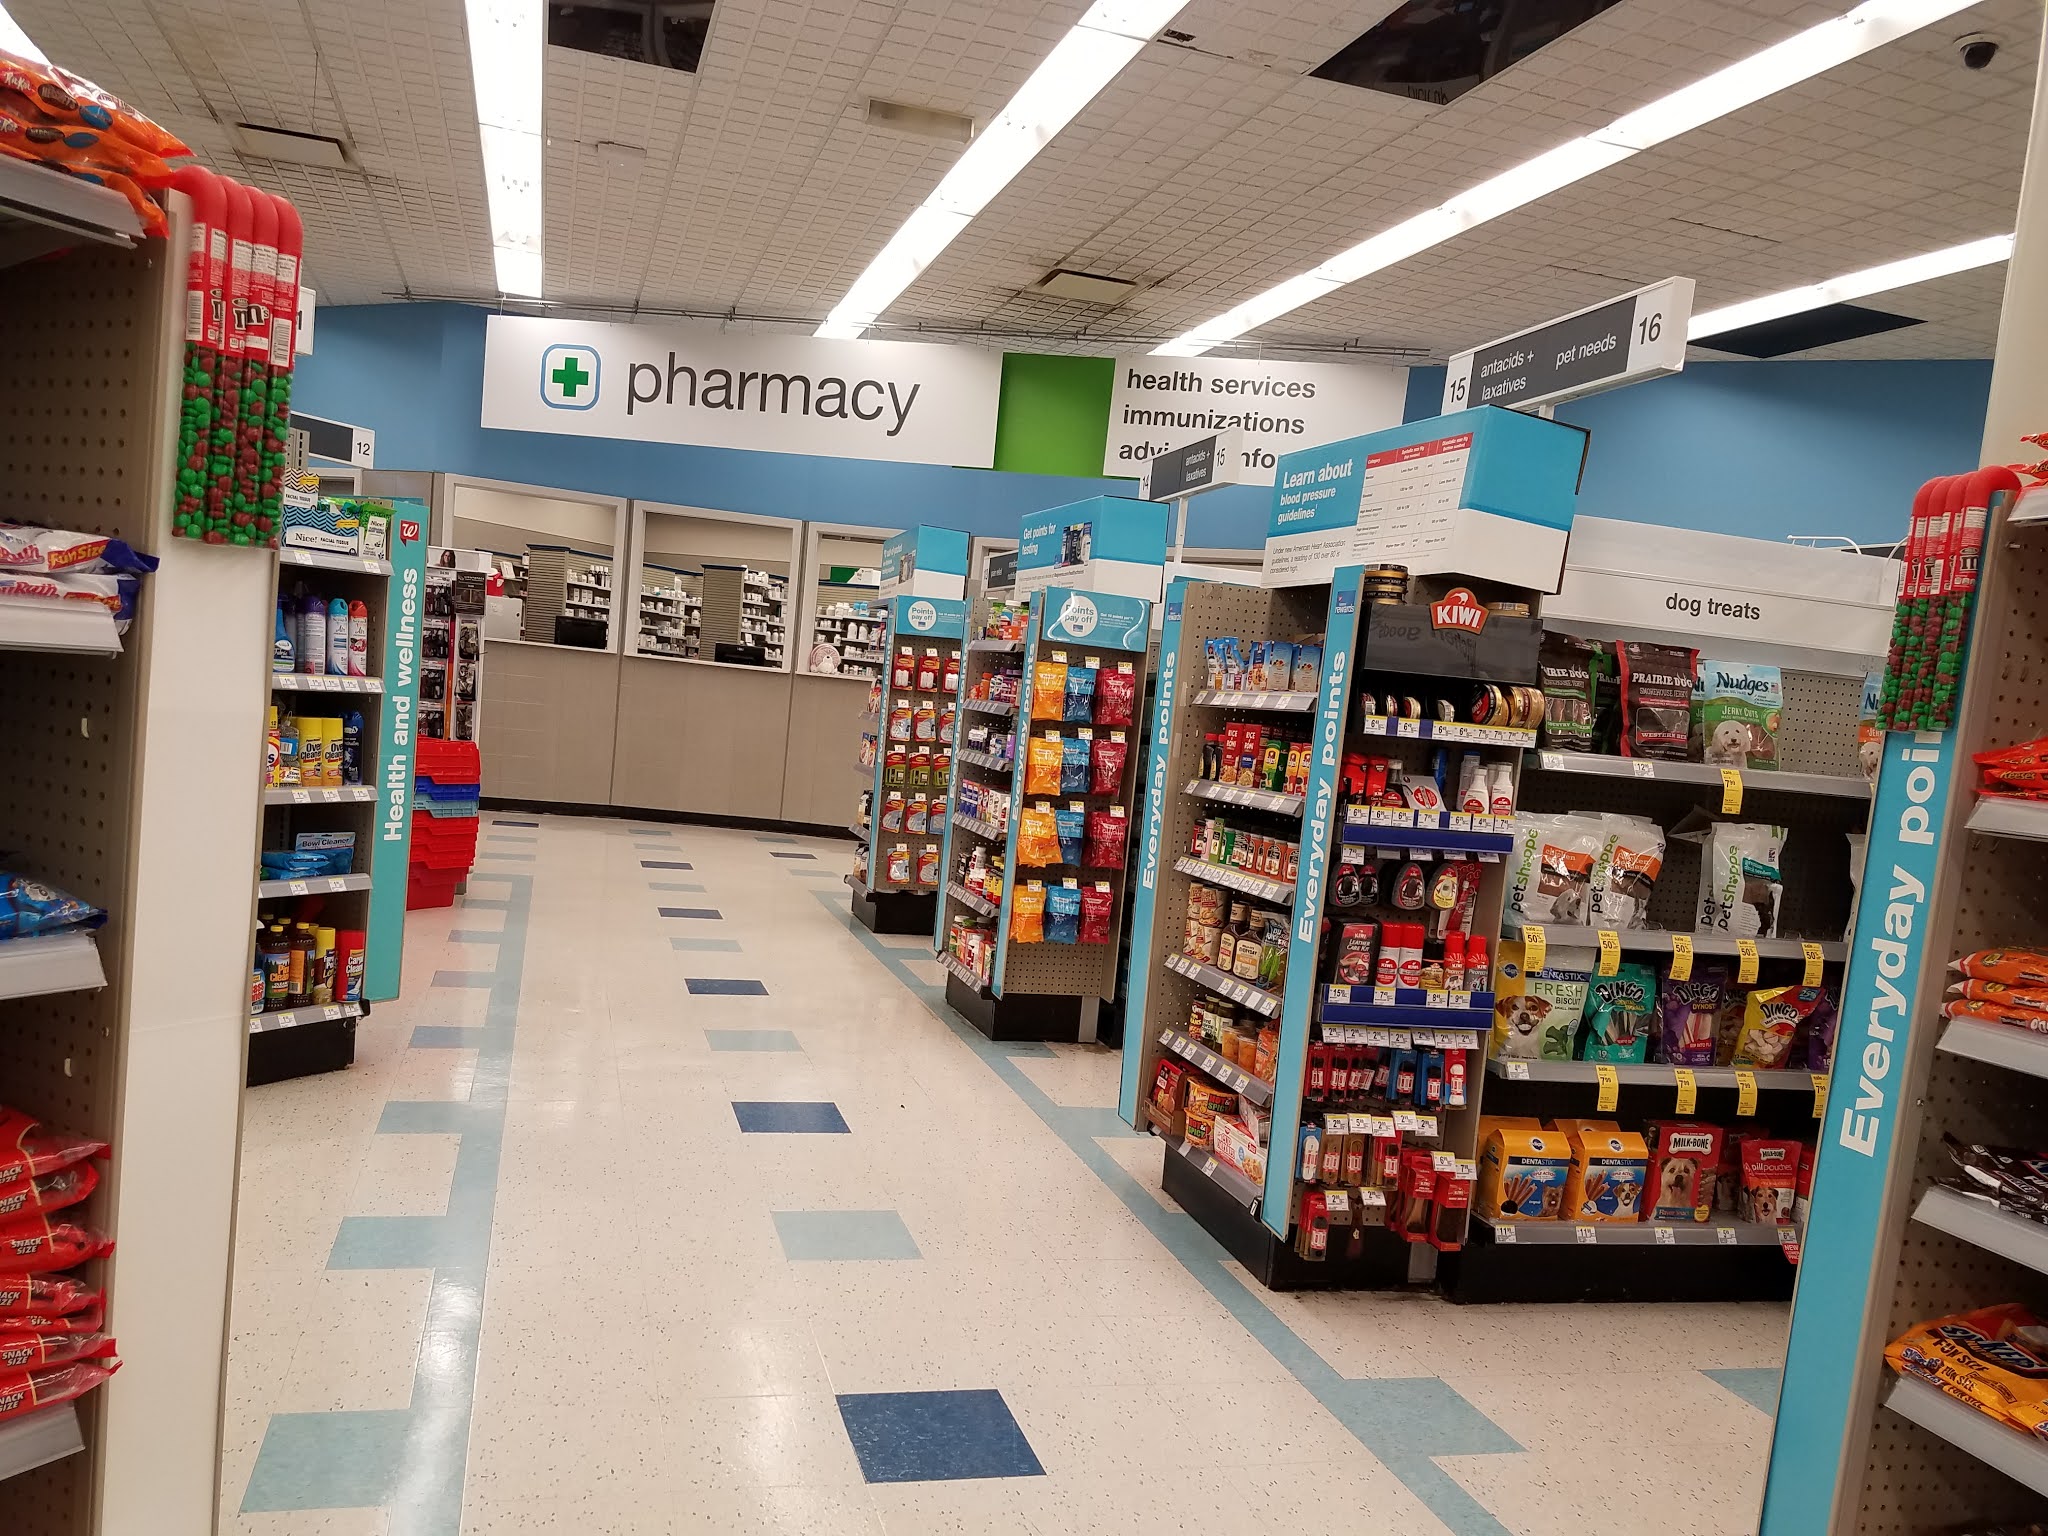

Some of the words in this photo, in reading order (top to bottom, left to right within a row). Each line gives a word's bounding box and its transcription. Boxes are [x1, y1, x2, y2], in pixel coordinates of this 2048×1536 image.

[1638, 312, 1662, 345] 16
[1555, 347, 1576, 370] pet
[1579, 333, 1617, 360] needs
[1480, 352, 1525, 378] antacids
[1527, 350, 1535, 362] +
[1127, 368, 1203, 393] health
[1210, 375, 1316, 399] services
[1449, 376, 1467, 403] 15
[1482, 376, 1527, 401] laxatives
[626, 352, 921, 437] pharmacy
[1122, 404, 1305, 435] immunizations
[356, 442, 371, 456] 12
[1185, 450, 1206, 466] antacids
[1216, 448, 1226, 467] 15
[1185, 467, 1207, 482] laxatives
[1283, 469, 1316, 489] Learn
[1318, 459, 1353, 482] about
[1280, 491, 1302, 506] blood
[1302, 487, 1337, 504] pressure
[295, 532, 318, 544] Nice!
[1023, 527, 1032, 540] Get
[1032, 524, 1048, 538] points
[1048, 523, 1056, 535] for
[1293, 544, 1311, 553] American
[911, 607, 934, 615] Points
[1065, 604, 1094, 615] Points
[1335, 604, 1355, 614] rewards
[1665, 592, 1701, 616] dog
[1707, 597, 1761, 620] treats
[1065, 614, 1079, 624] pay
[1081, 614, 1093, 624] off
[1437, 605, 1482, 629] KIWI
[397, 568, 419, 689] wellness
[1569, 663, 1590, 679] DOG
[1632, 672, 1674, 686] PRAIRIE
[1674, 672, 1693, 688] DOG
[1716, 671, 1769, 695] Nudges
[1639, 688, 1673, 698] SMOKEHOUSE
[1722, 705, 1743, 716] JERKY
[1743, 707, 1759, 718] CUTS
[392, 696, 410, 746] and
[1142, 753, 1167, 890] Everyday
[1158, 651, 1176, 745] points
[384, 754, 407, 841] Health
[1298, 777, 1333, 944] Everyday
[1321, 650, 1346, 766] points
[302, 839, 321, 848] Bowl
[322, 837, 350, 846] Cleaner
[1534, 982, 1583, 998] FRESH
[1595, 980, 1646, 1003] DINGO
[1555, 997, 1581, 1006] BISCUIT
[1759, 1002, 1799, 1019] DINGO
[1840, 864, 1925, 1157] Everyday
[1209, 1093, 1225, 1103] HOT
[1187, 1126, 1205, 1137] SPICY
[1188, 1118, 1201, 1129] HOT
[0, 1203, 22, 1213] SIZE
[11, 1237, 43, 1249] SNACK
[16, 1246, 37, 1255] SIZE
[2, 1348, 34, 1360] SNACK
[7, 1357, 28, 1367] SIZE
[1932, 1337, 1959, 1362] FUN
[1958, 1354, 1990, 1372] SIZE
[1941, 1365, 1957, 1381] FUN
[1956, 1375, 1977, 1393] SIZE
[1947, 1385, 1965, 1400] FUN
